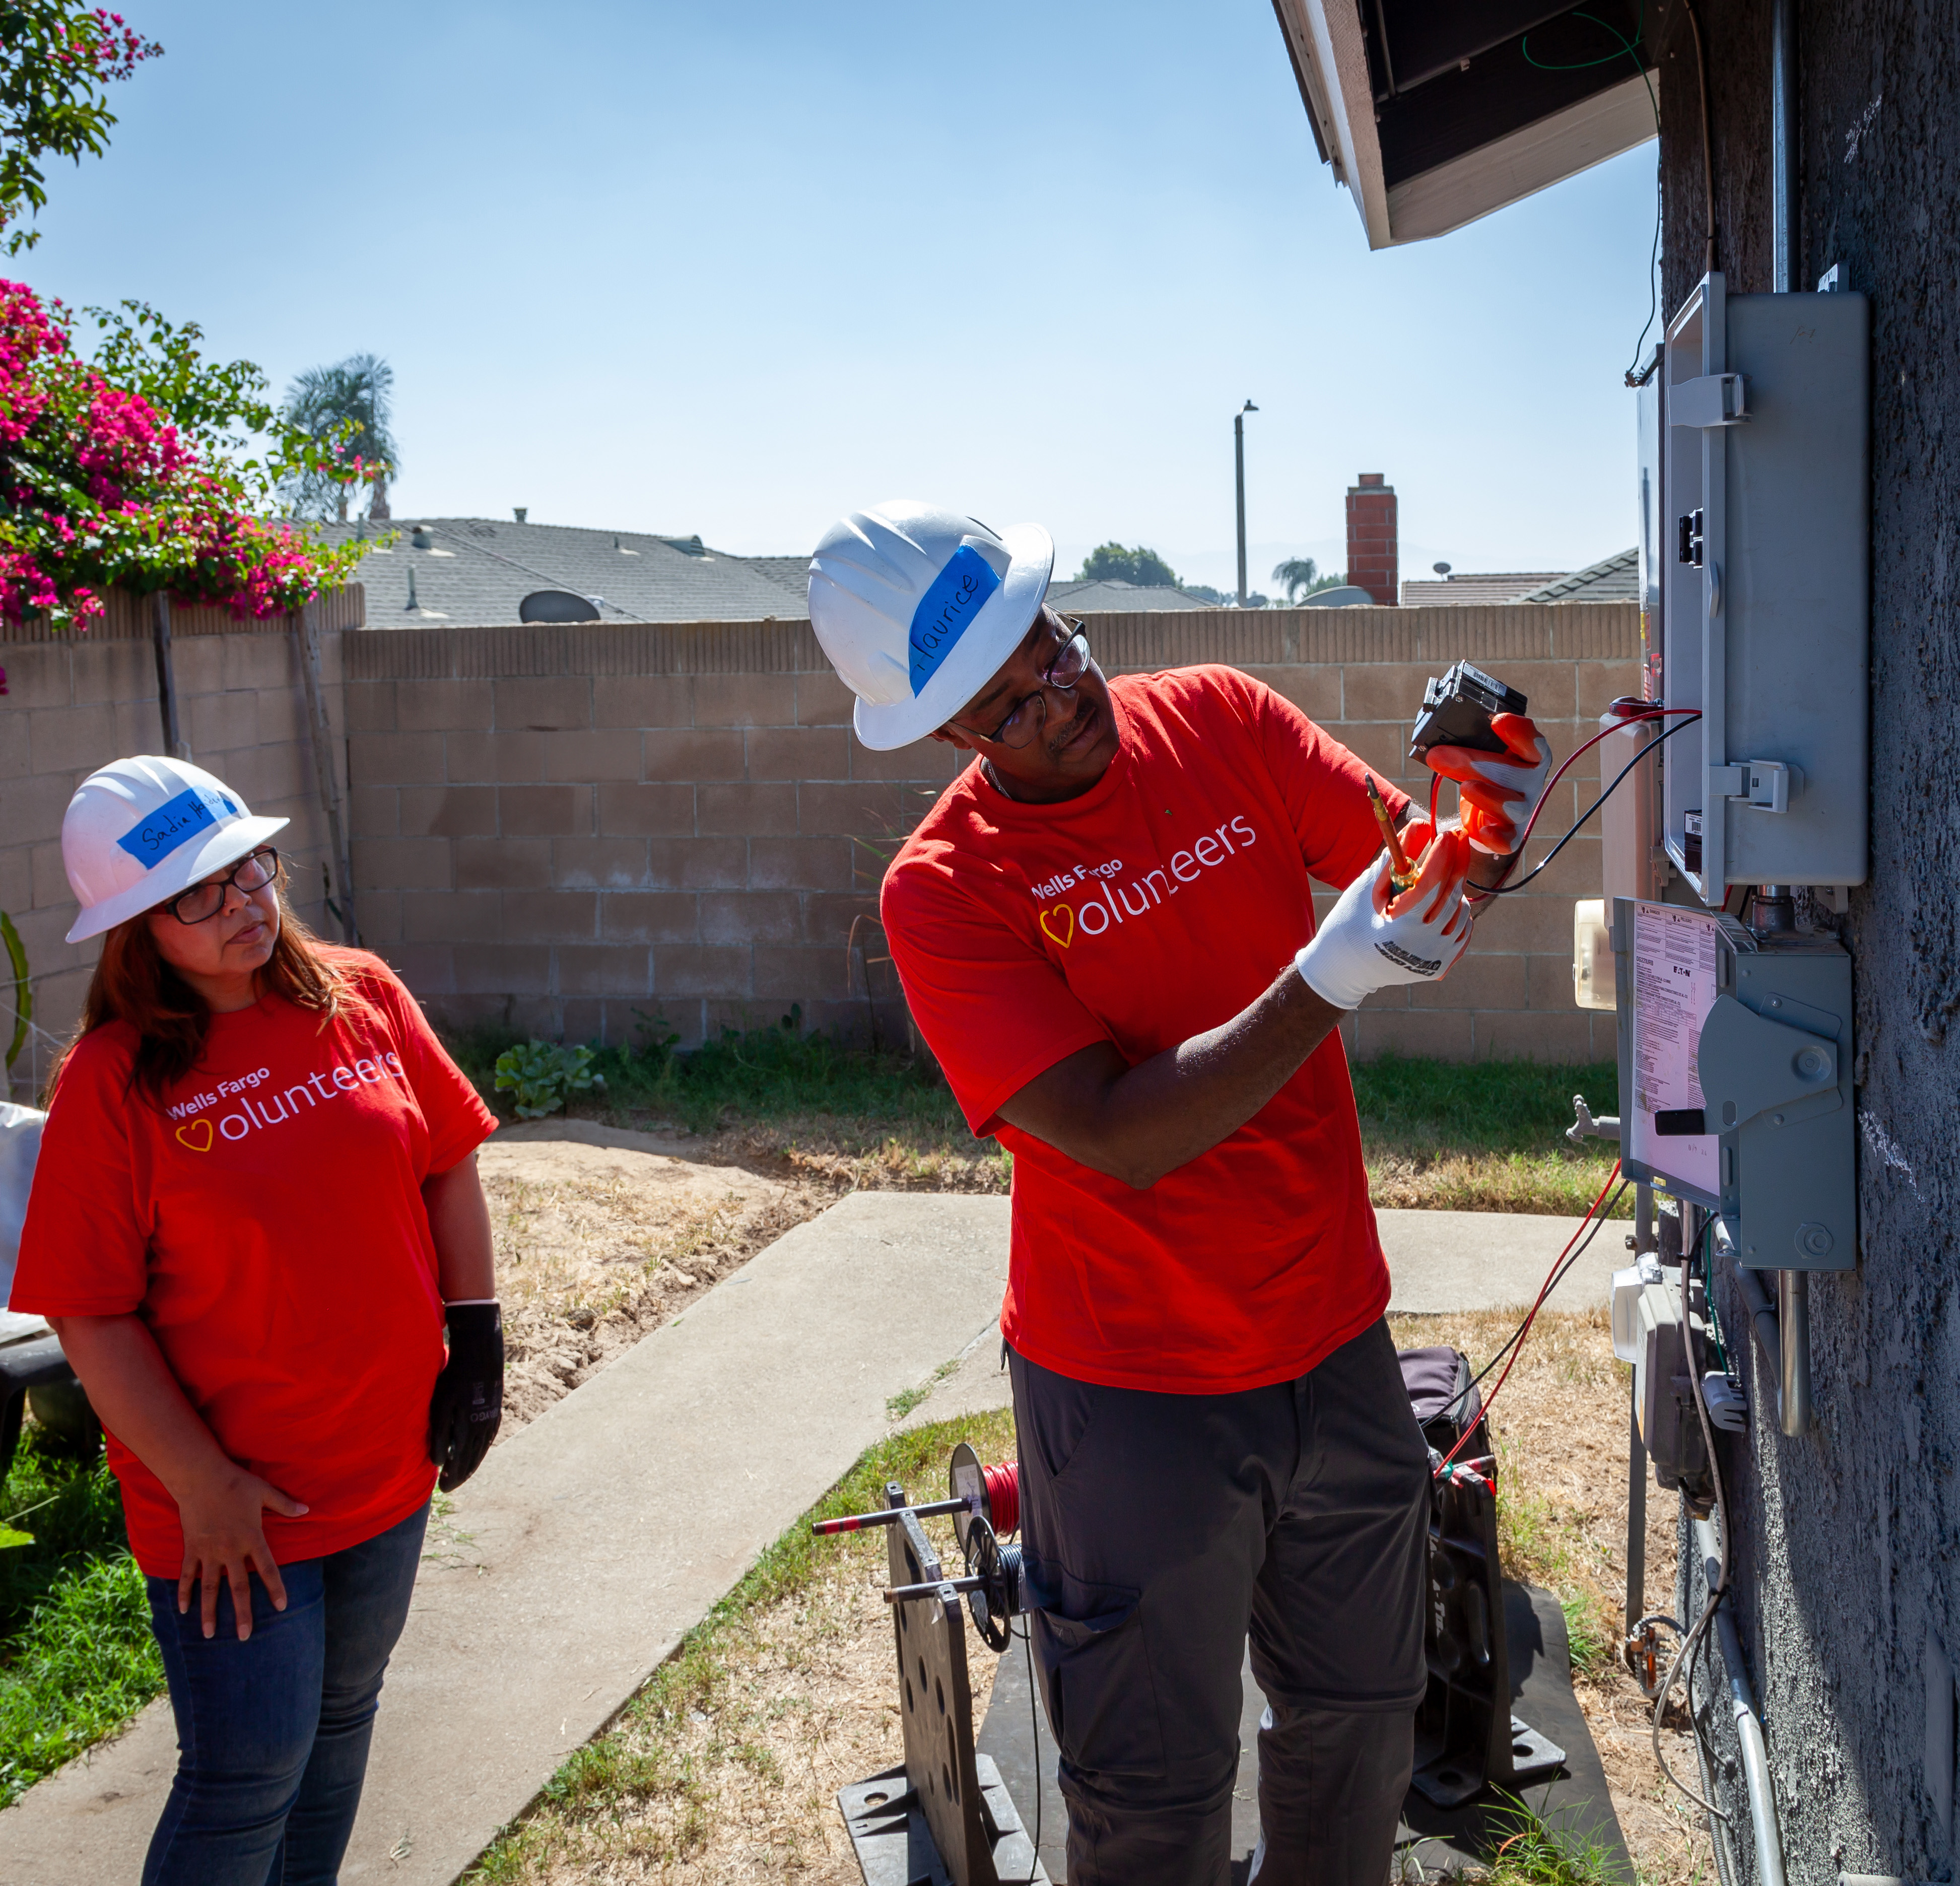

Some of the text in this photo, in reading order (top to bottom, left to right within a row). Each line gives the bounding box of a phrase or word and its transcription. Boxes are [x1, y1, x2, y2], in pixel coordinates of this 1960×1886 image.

[142, 815, 191, 850] Sadia
[1072, 859, 1123, 881] Frgo
[1673, 965, 1691, 978] EATON
[165, 1067, 270, 1120] Wells Fargo
